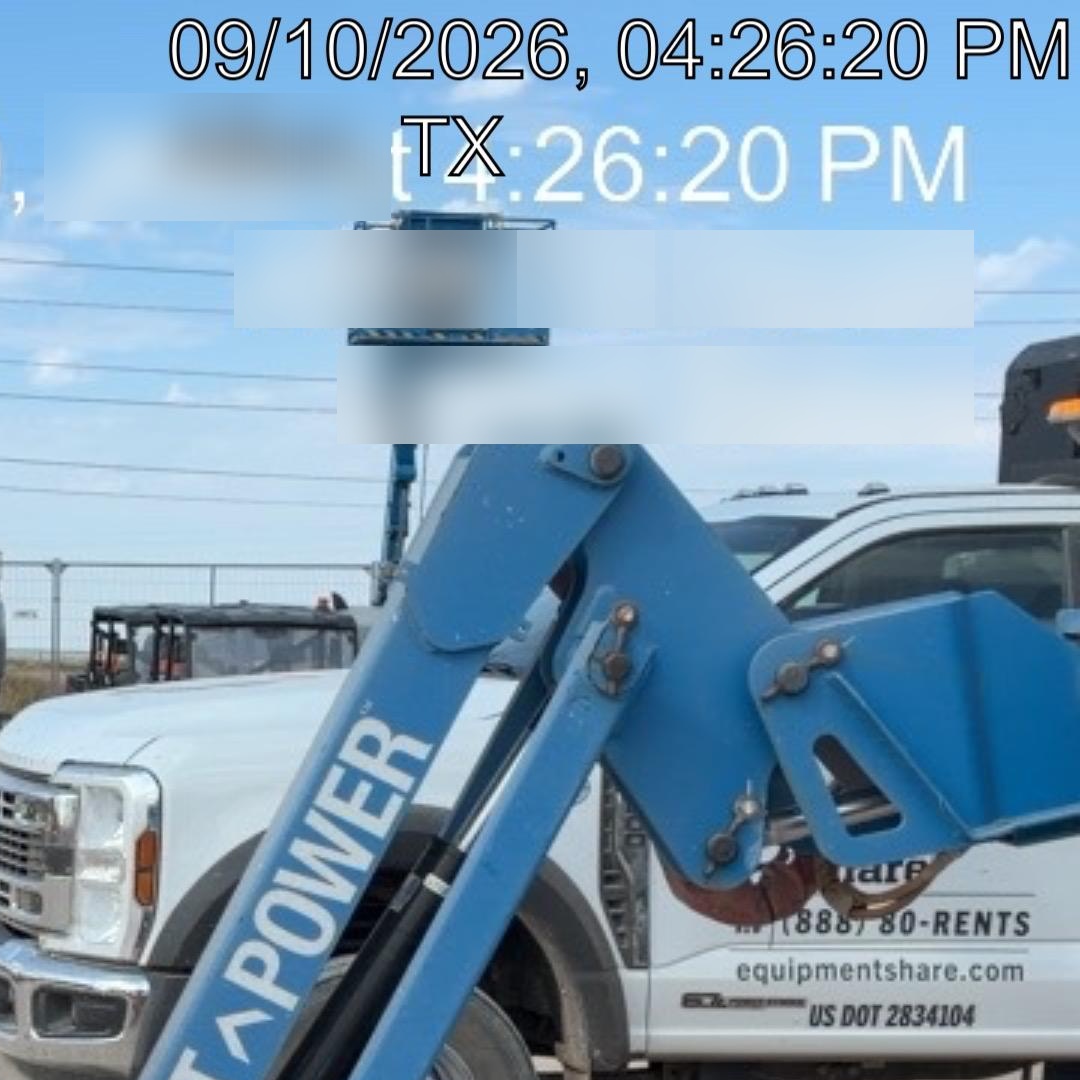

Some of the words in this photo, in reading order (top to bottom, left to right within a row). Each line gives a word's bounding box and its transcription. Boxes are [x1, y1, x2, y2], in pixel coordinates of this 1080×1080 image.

[224, 715, 434, 1013] POWER
[879, 909, 1032, 937] 80-RENTS
[735, 957, 1025, 985] equipmentshare.com
[809, 1004, 836, 1027] US
[839, 1004, 883, 1027] DOT
[884, 1004, 976, 1027] 2834104
